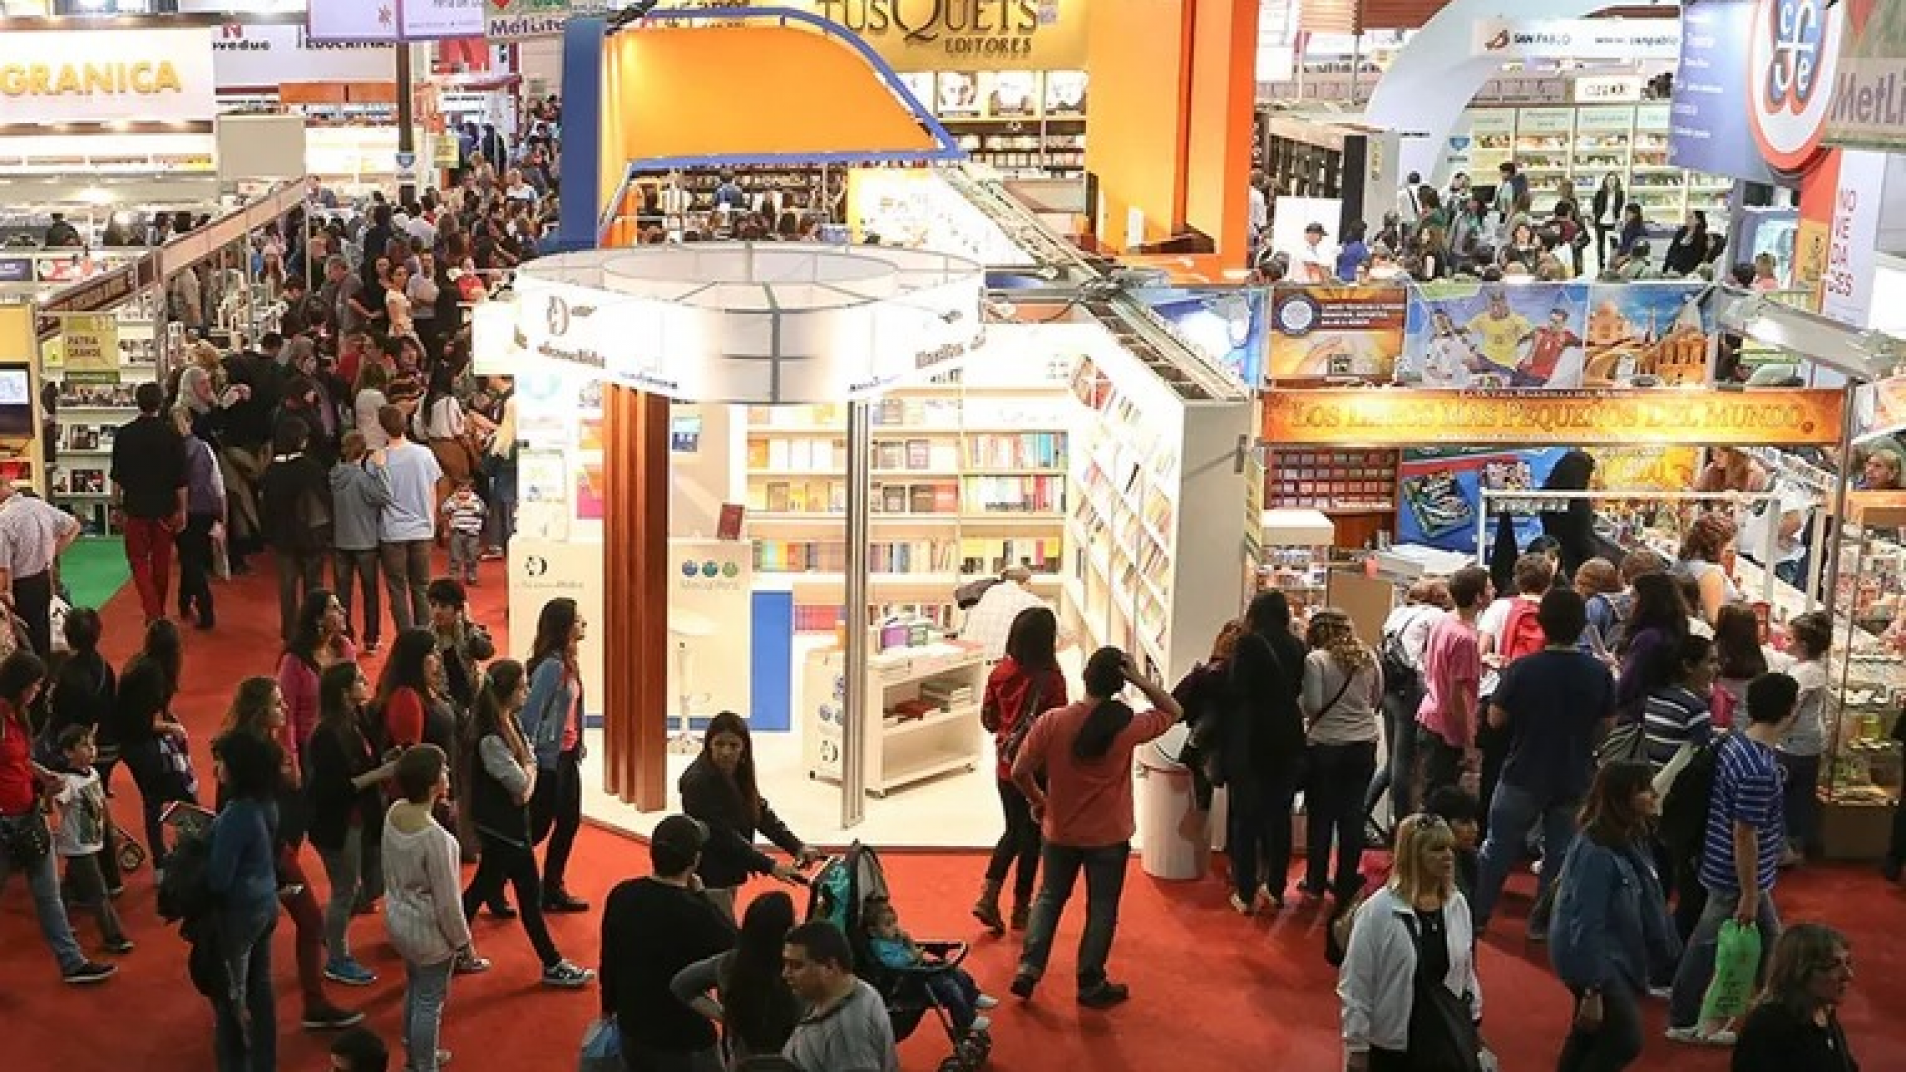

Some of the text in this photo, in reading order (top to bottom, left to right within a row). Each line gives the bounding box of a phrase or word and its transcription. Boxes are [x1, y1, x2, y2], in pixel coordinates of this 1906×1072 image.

[814, 0, 1037, 43] TUSQUETS
[945, 38, 1032, 54] EDITORES
[1, 60, 182, 96] GRANICA
[1290, 401, 1341, 428] LOS
[1705, 401, 1805, 428] MUNDO
